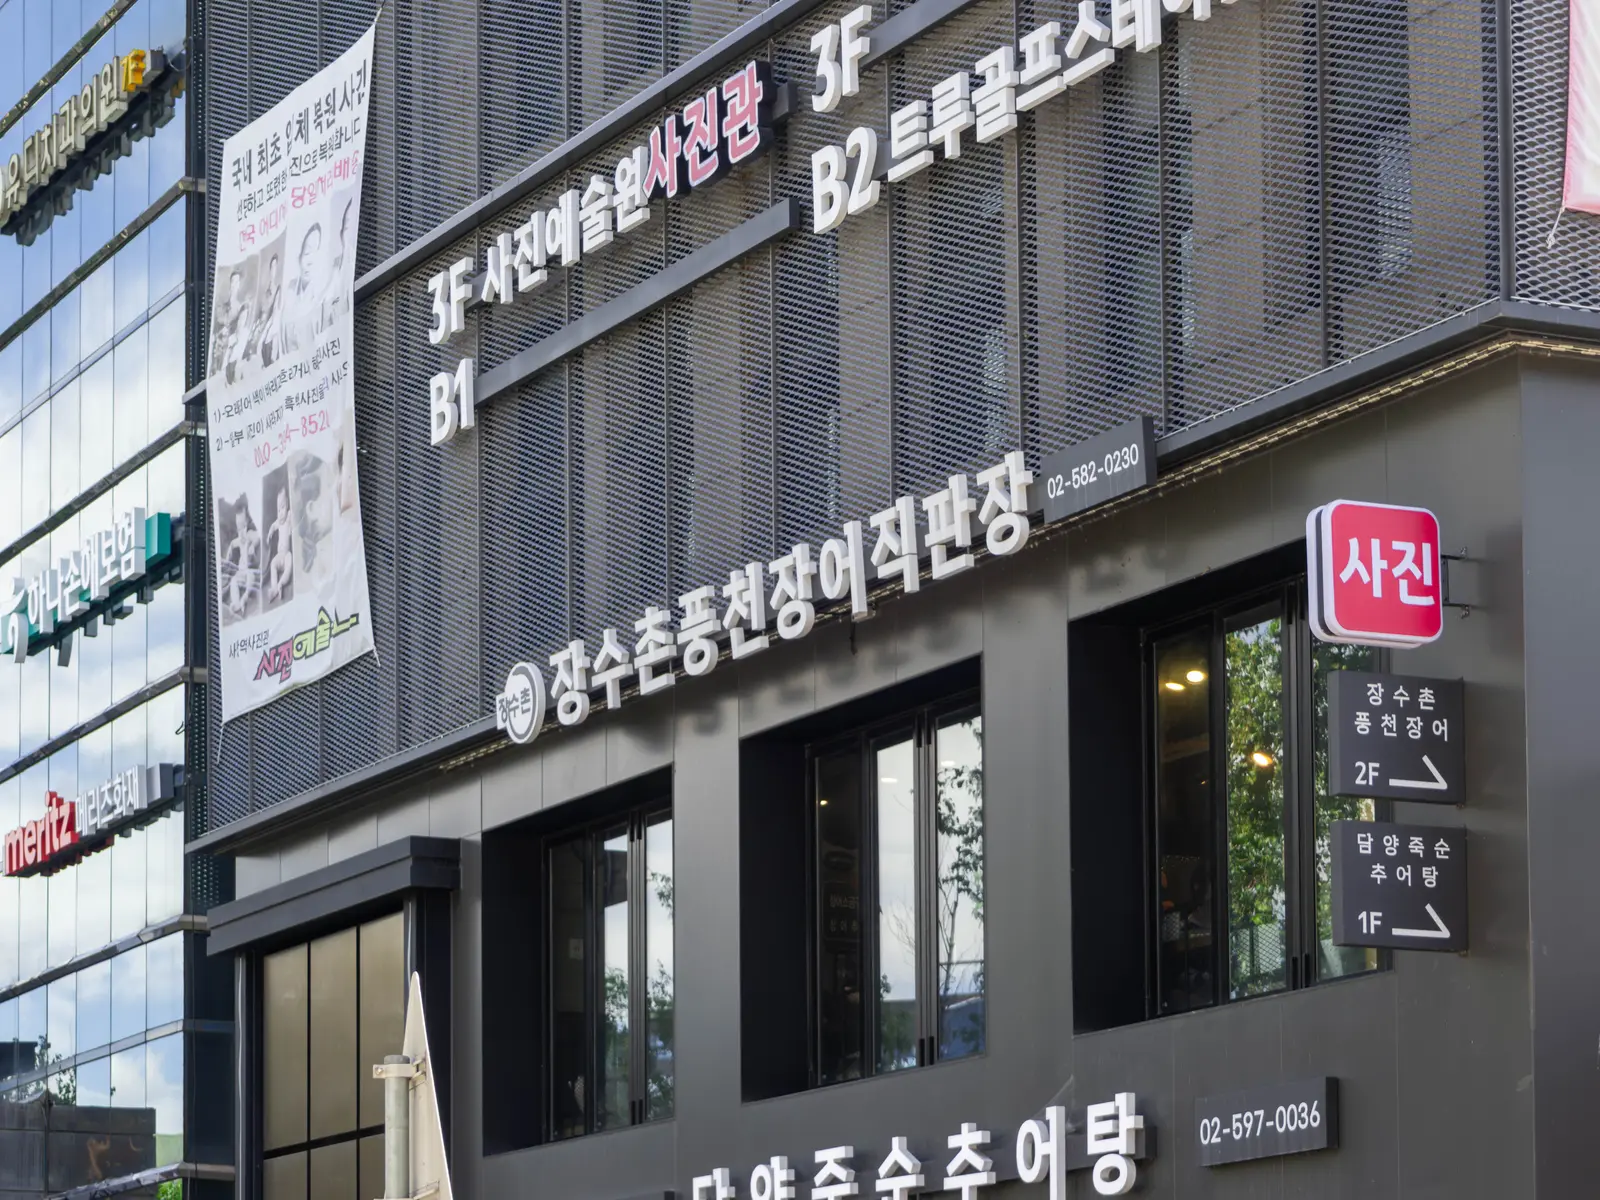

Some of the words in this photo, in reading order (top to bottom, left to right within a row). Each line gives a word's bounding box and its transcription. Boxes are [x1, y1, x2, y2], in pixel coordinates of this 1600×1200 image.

[810, 4, 872, 113] 3F
[258, 132, 282, 175] 최초
[811, 126, 881, 235] B2
[427, 256, 473, 345] 3F
[429, 357, 475, 447] B1
[1046, 443, 1140, 500] 02-582-0230
[27, 507, 146, 635] 하나손해보험
[1339, 537, 1435, 606] 사진
[498, 687, 531, 724] 장수촌
[1354, 761, 1381, 786] 2F
[5, 791, 80, 876] meritz
[75, 765, 148, 836] 메리츠화재
[1357, 911, 1383, 935] 1F
[1200, 1099, 1322, 1147] 02-597-0036
